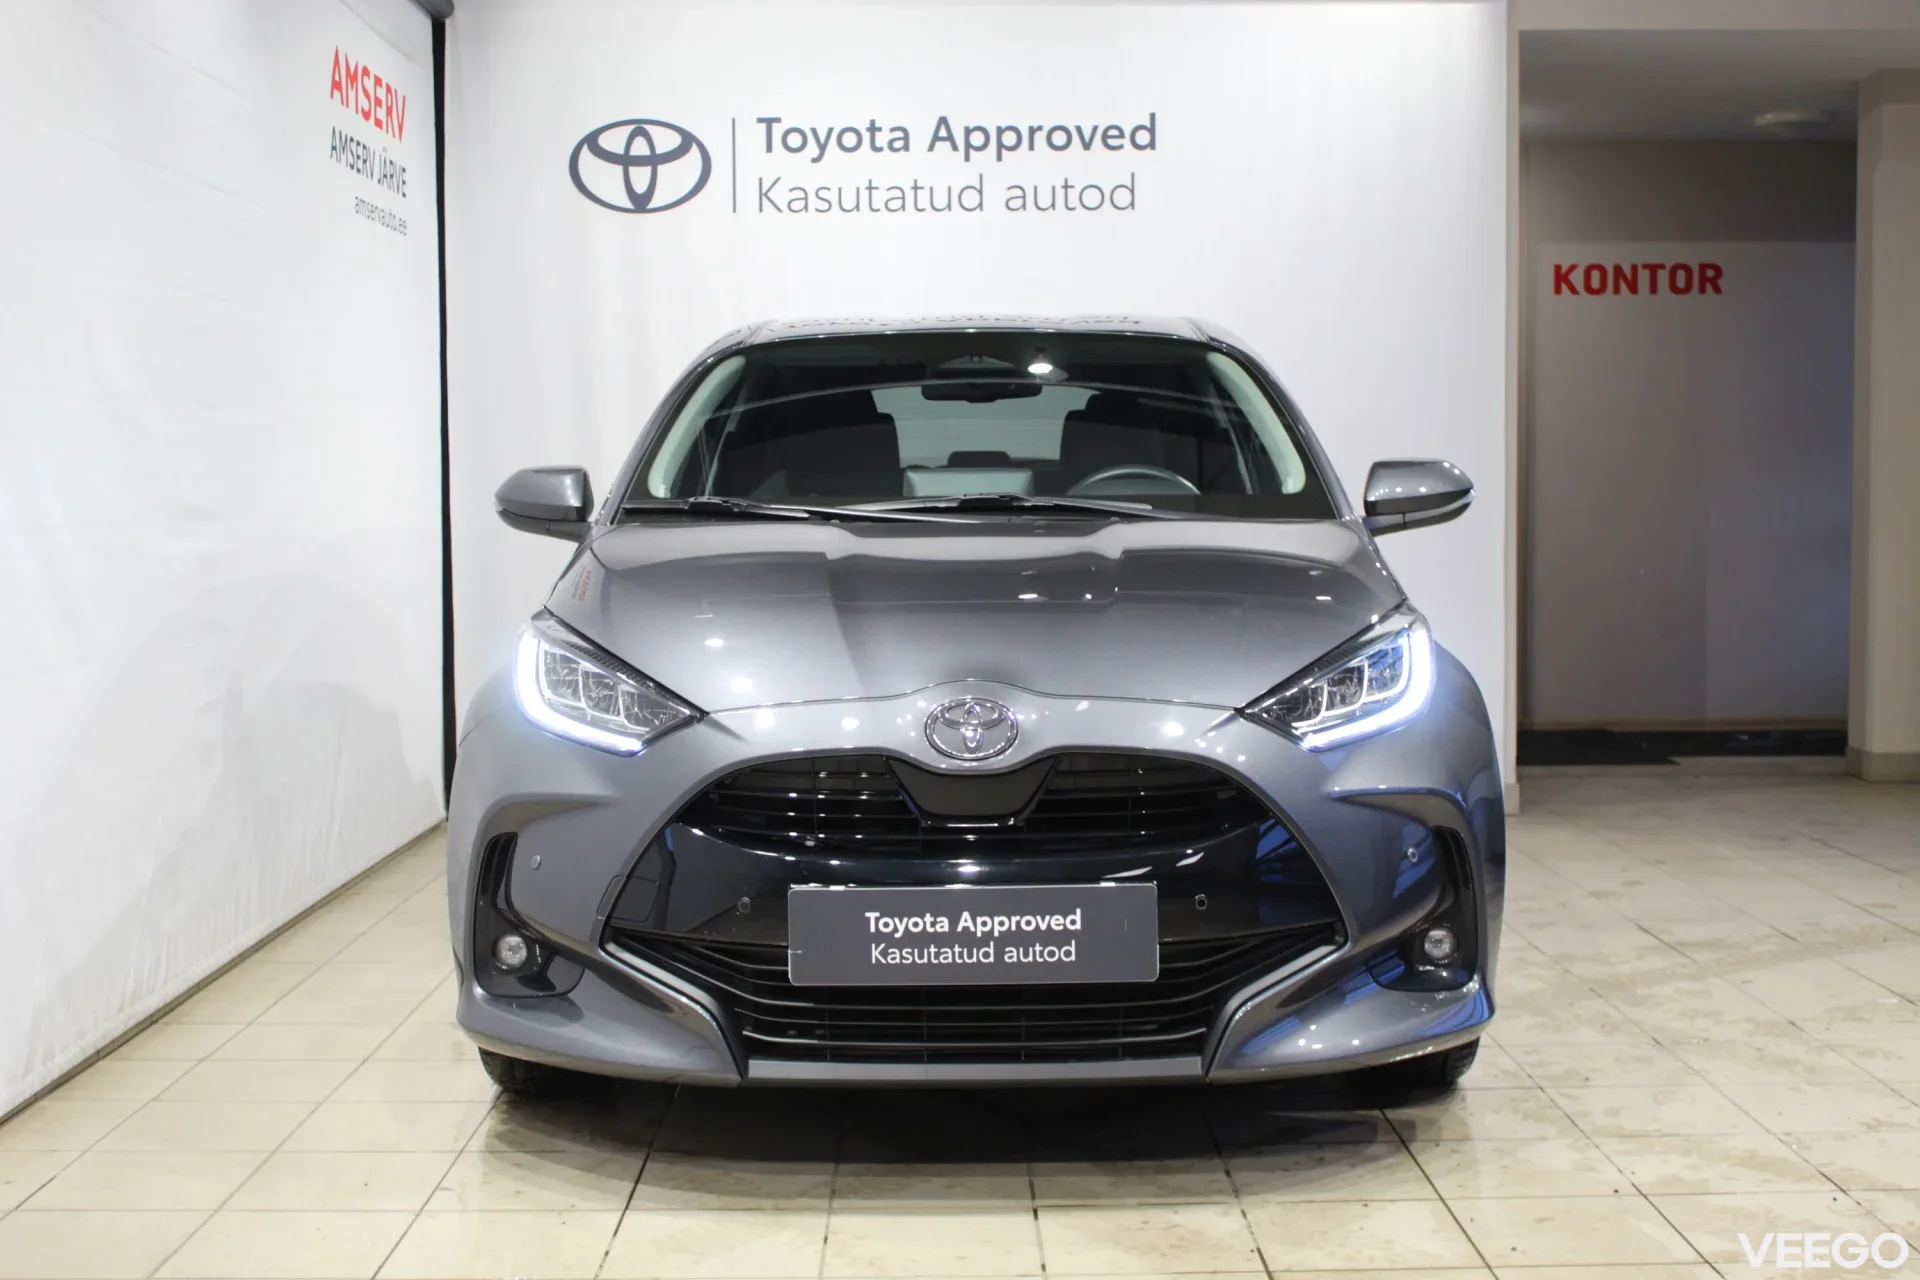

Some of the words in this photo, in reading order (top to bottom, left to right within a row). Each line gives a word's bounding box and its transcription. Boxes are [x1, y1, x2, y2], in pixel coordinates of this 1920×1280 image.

[329, 45, 406, 142] AMSERV
[756, 117, 911, 163] Toyota
[927, 112, 1157, 162] Approved
[330, 126, 375, 181] AMSERV
[377, 146, 407, 198] JÄRVE
[758, 174, 984, 213] Kasutatud
[1004, 172, 1136, 212] autod
[355, 196, 407, 236] amservauto.ee
[1553, 263, 1723, 296] KONTOR
[865, 911, 949, 938] Toyota
[956, 908, 1082, 937] Approved
[871, 942, 995, 964] Kasutatud
[1003, 940, 1077, 963] autod
